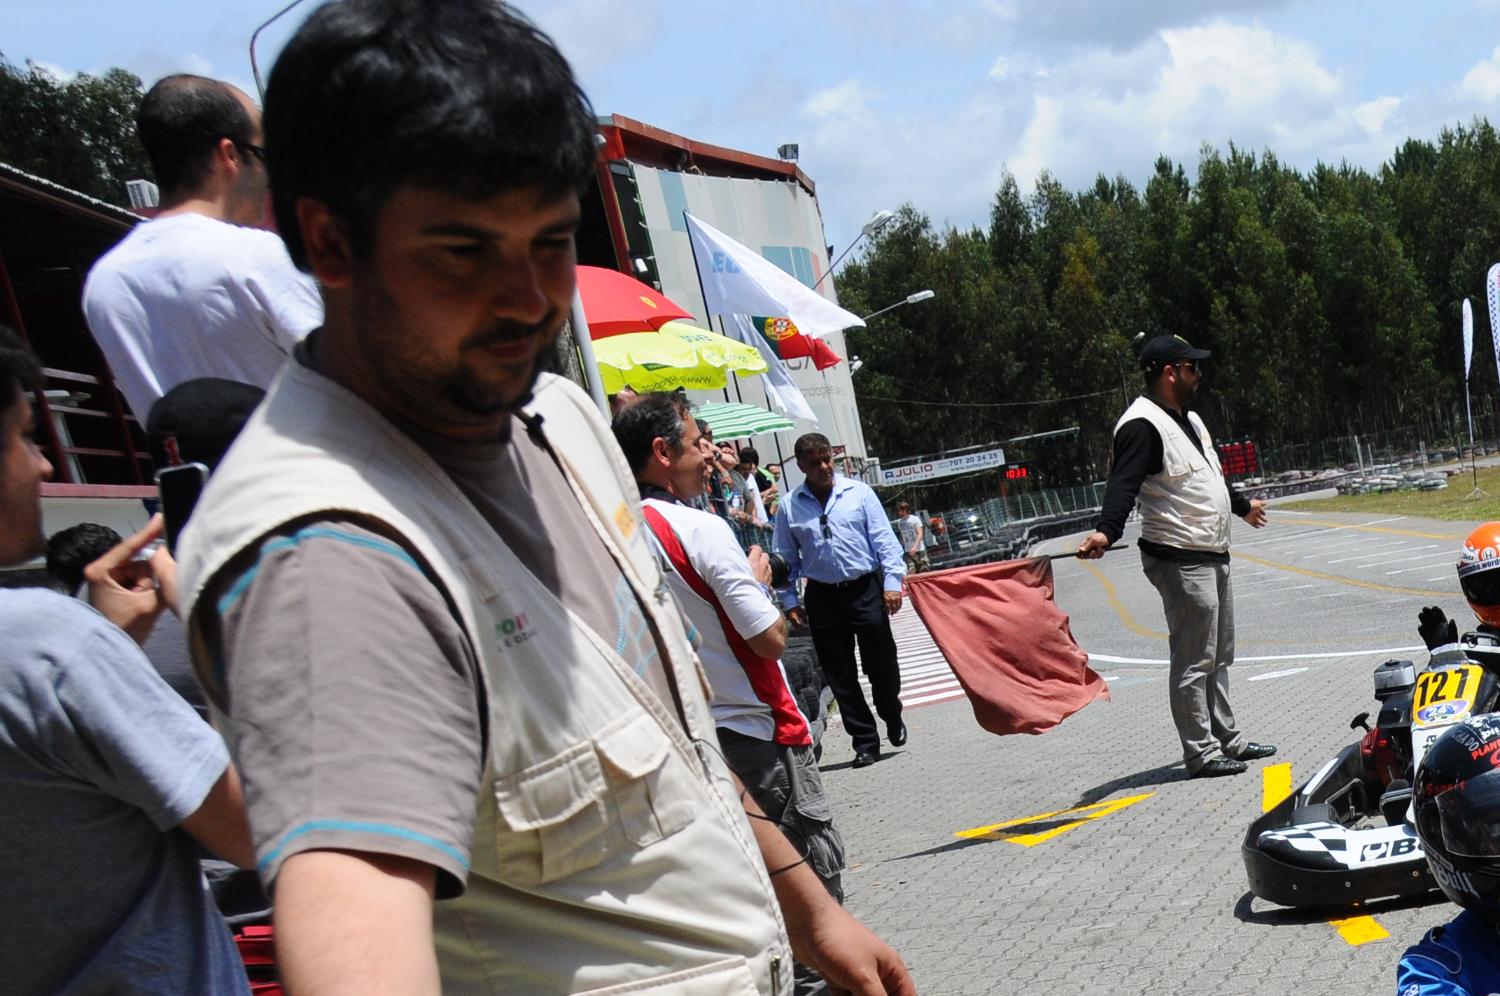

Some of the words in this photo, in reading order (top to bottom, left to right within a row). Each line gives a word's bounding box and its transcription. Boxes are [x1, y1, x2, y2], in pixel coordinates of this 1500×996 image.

[949, 458, 963, 467] 707
[965, 456, 975, 465] 20
[976, 454, 987, 463] 24
[987, 452, 999, 461] 25
